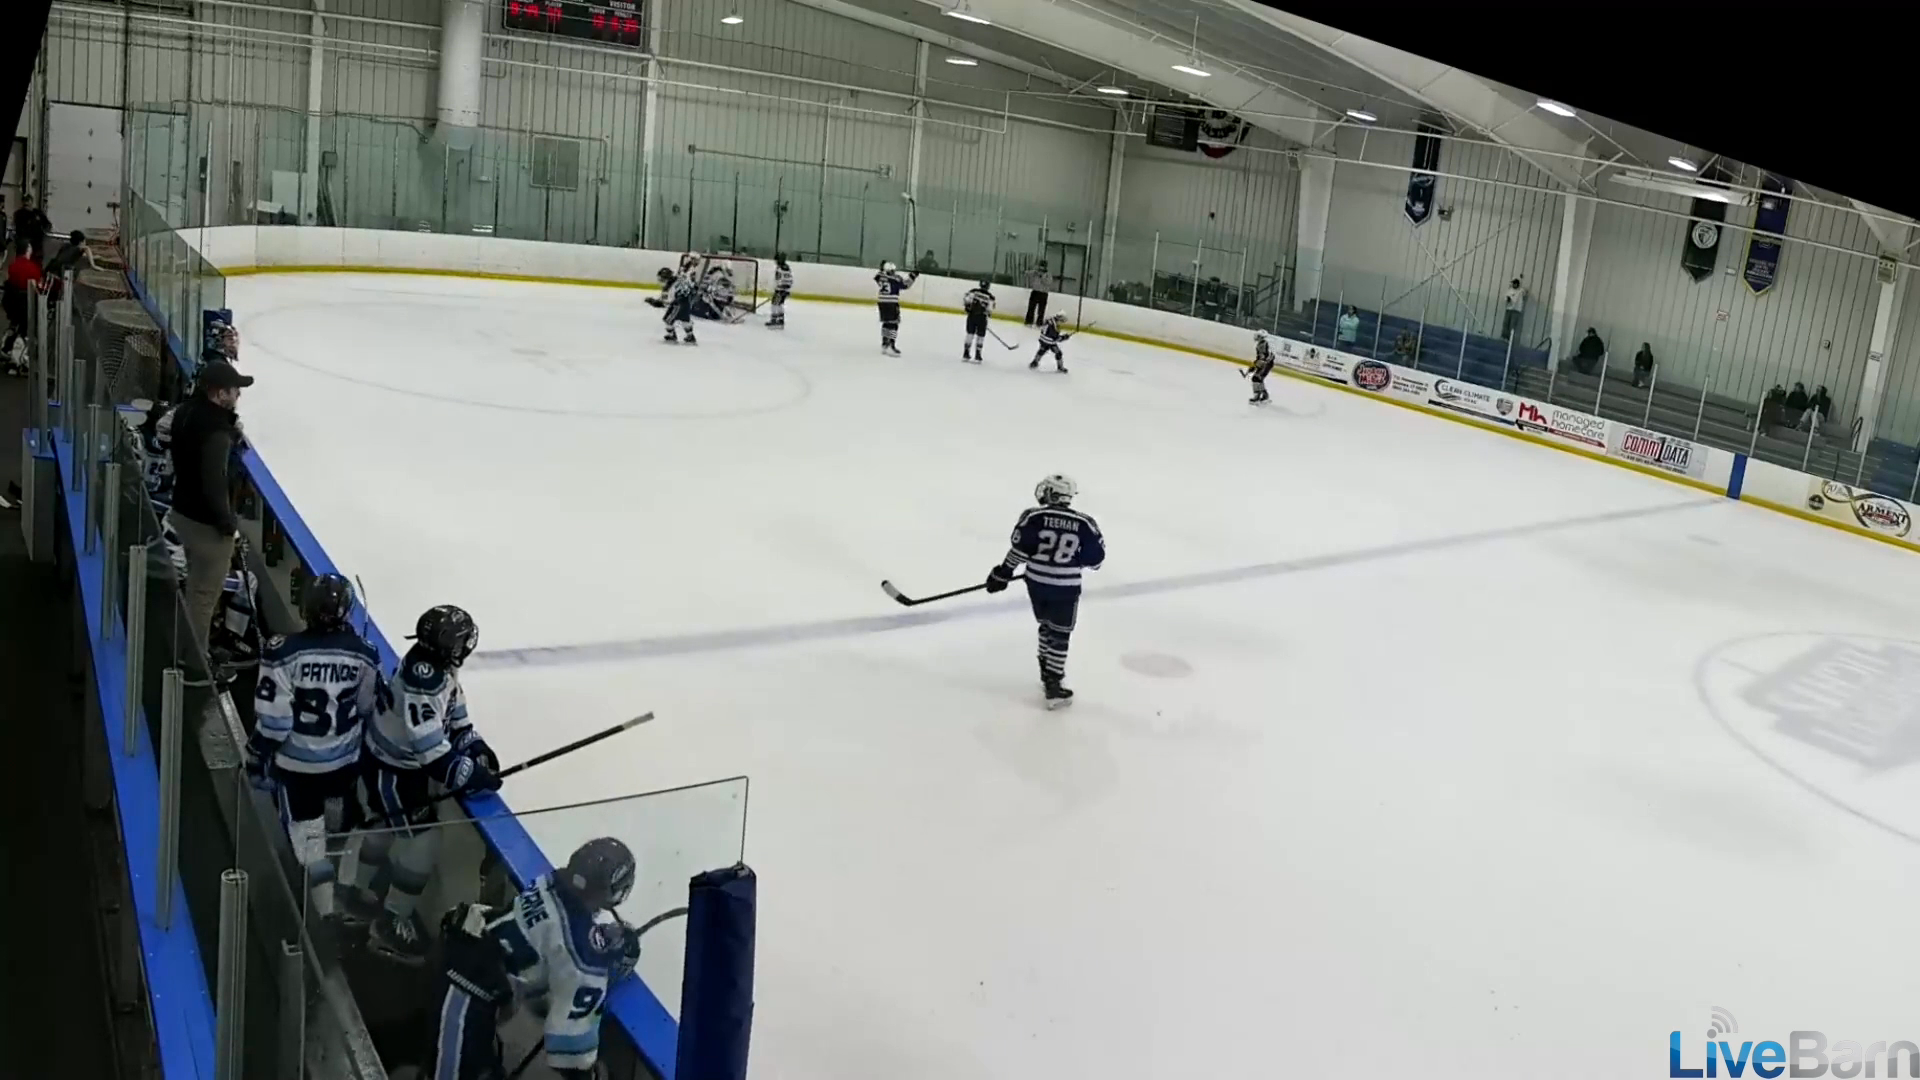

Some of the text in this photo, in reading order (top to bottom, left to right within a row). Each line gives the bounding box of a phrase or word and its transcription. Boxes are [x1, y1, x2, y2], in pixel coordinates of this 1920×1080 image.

[609, 1, 636, 10] VISITOR
[1551, 418, 1605, 440] homecare
[1553, 409, 1605, 430] managed
[1043, 516, 1079, 532] TEEHAN
[1031, 529, 1080, 563] 28
